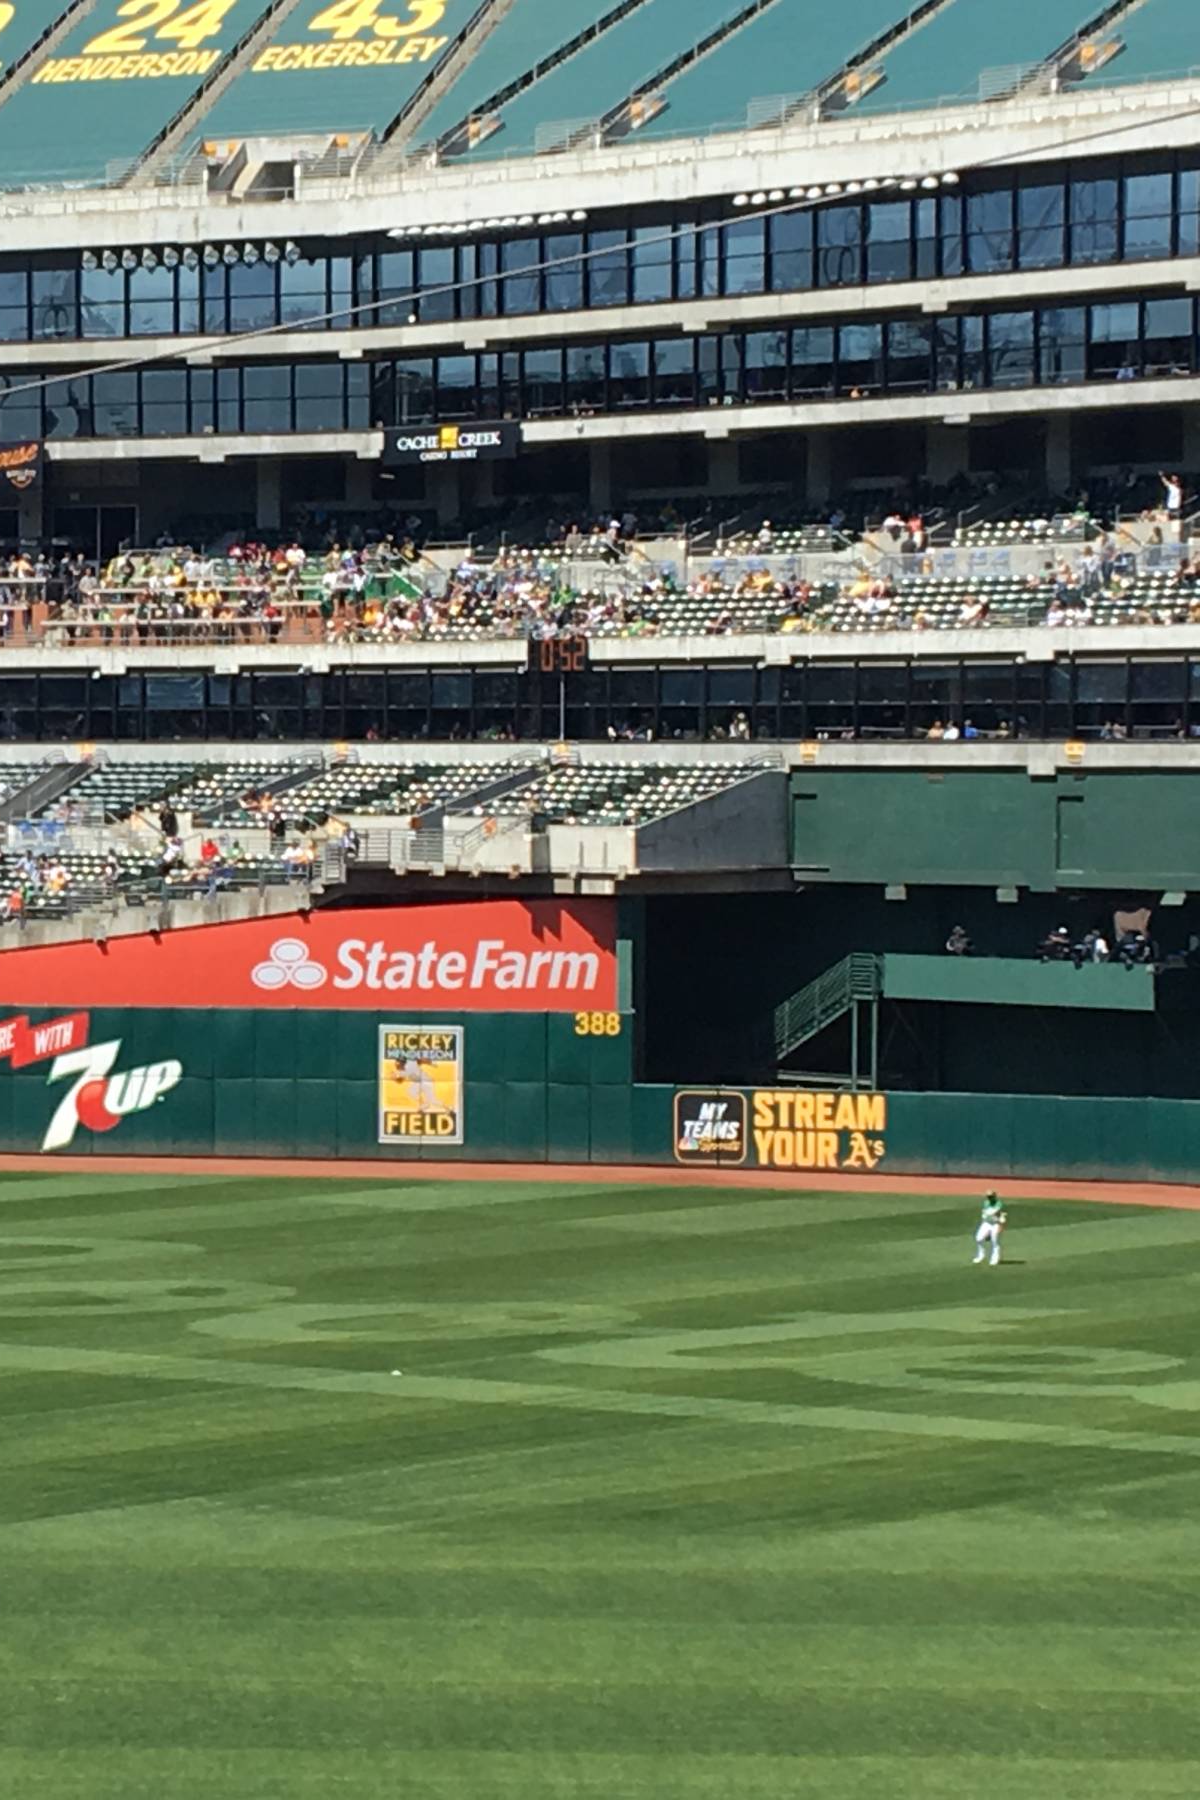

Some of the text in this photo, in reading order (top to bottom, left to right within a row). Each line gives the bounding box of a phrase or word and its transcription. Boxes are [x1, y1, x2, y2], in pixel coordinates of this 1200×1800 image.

[81, 0, 237, 54] 24
[308, 0, 446, 39] 43
[31, 50, 221, 84] HENDERSON
[251, 36, 448, 72] ECKERSLEY
[458, 431, 502, 447] CREEK
[34, 1020, 74, 1056] WITH
[387, 1033, 453, 1049] RICKEY
[574, 1012, 621, 1037] 388
[386, 1112, 454, 1135] FIELD
[698, 1102, 727, 1120] MY
[753, 1091, 886, 1131] STREAM
[683, 1120, 741, 1139] TEAMS
[753, 1130, 839, 1168] YOUR
